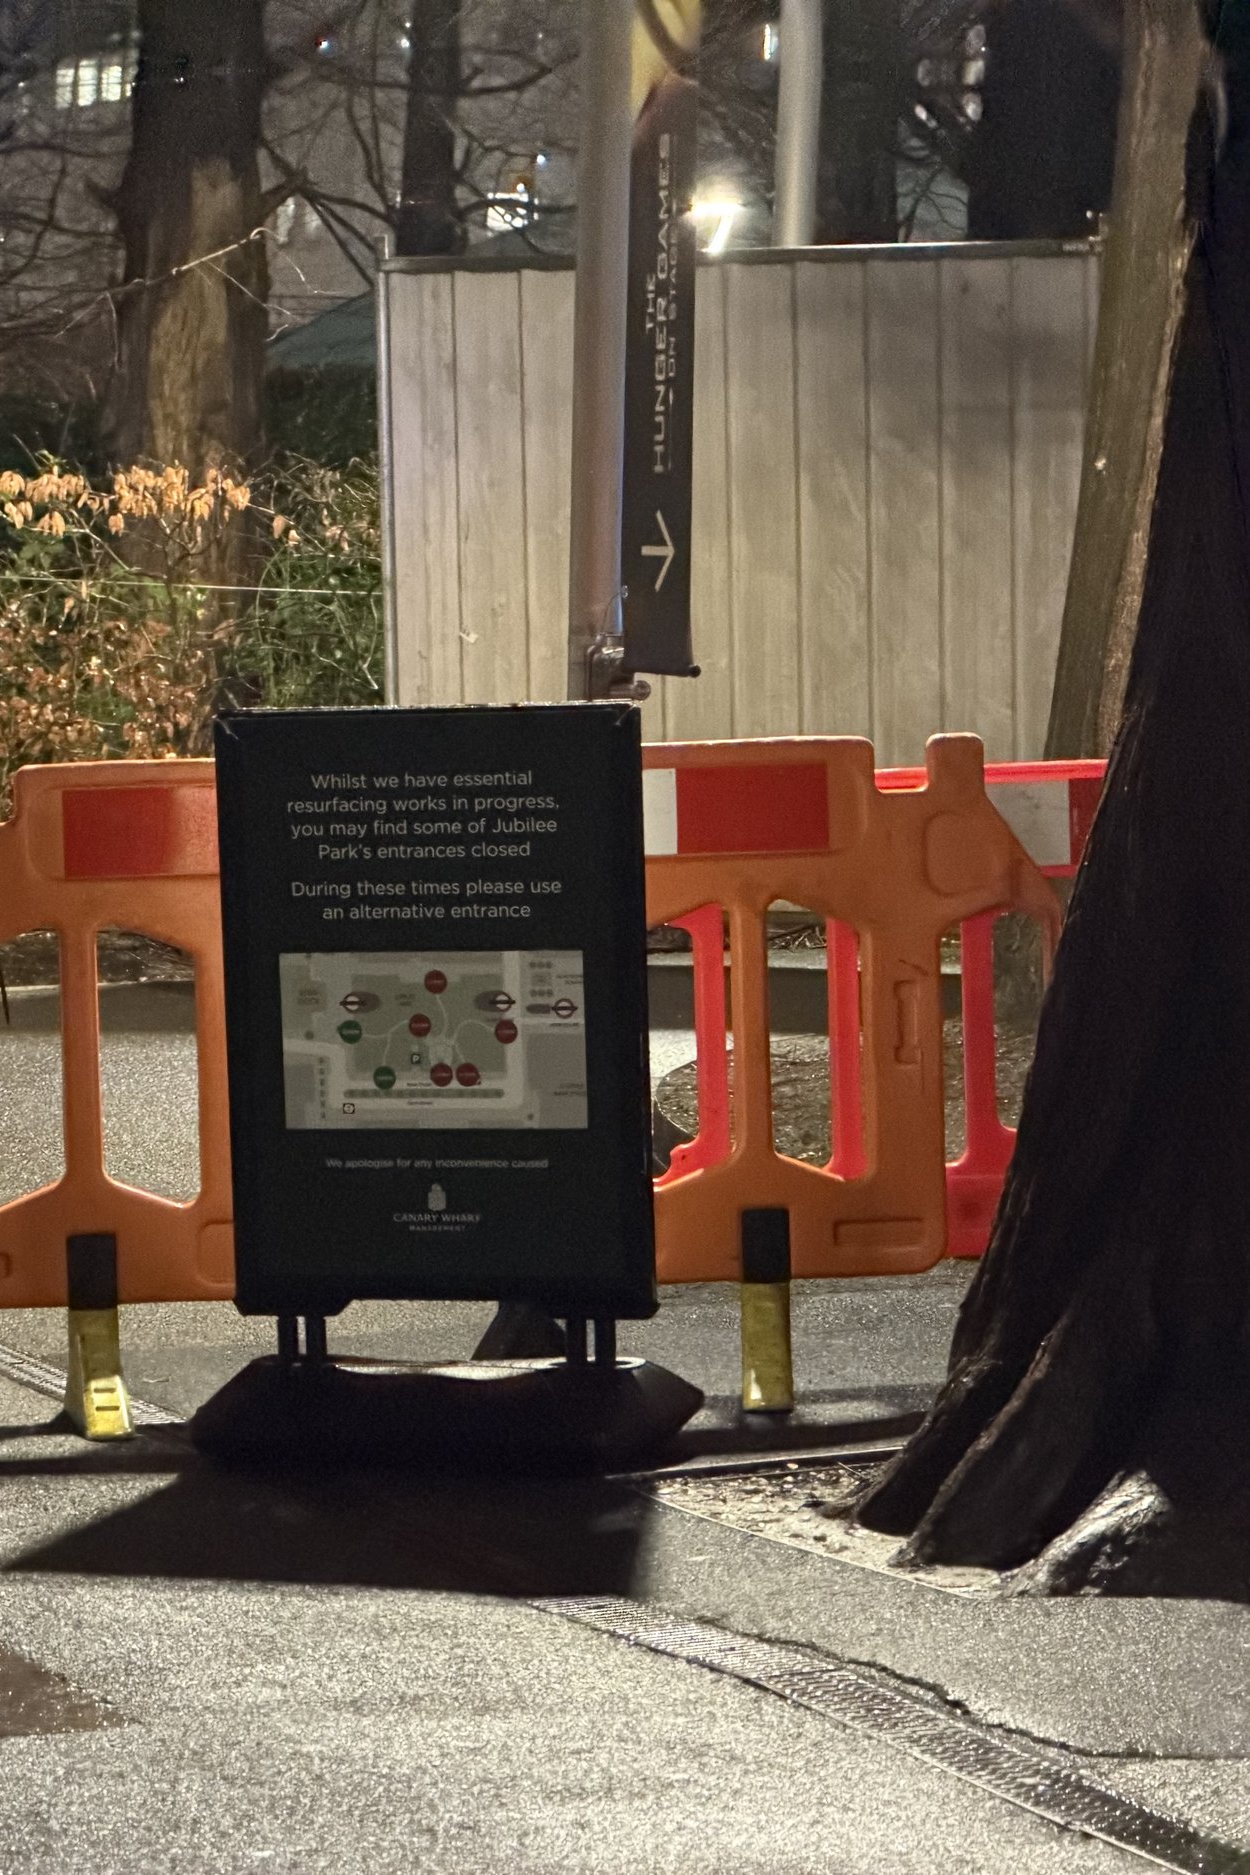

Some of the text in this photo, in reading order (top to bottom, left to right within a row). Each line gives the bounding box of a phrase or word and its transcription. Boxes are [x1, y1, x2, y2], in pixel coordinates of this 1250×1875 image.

[646, 274, 655, 331] THE
[652, 133, 670, 473] HUNGER GAMES
[668, 337, 676, 377] ON
[311, 770, 532, 789] Whilst we have essential
[287, 795, 559, 814] resurfacing works in progress,
[291, 817, 557, 839] you may find some of Jubilee
[319, 842, 530, 859] Park's entrances closed
[292, 879, 561, 898] During these times please use
[323, 904, 530, 919] an alternative entrance
[326, 1158, 548, 1169] We apologise for any inconvenience caused
[393, 1213, 480, 1223] CANARY WHARF
